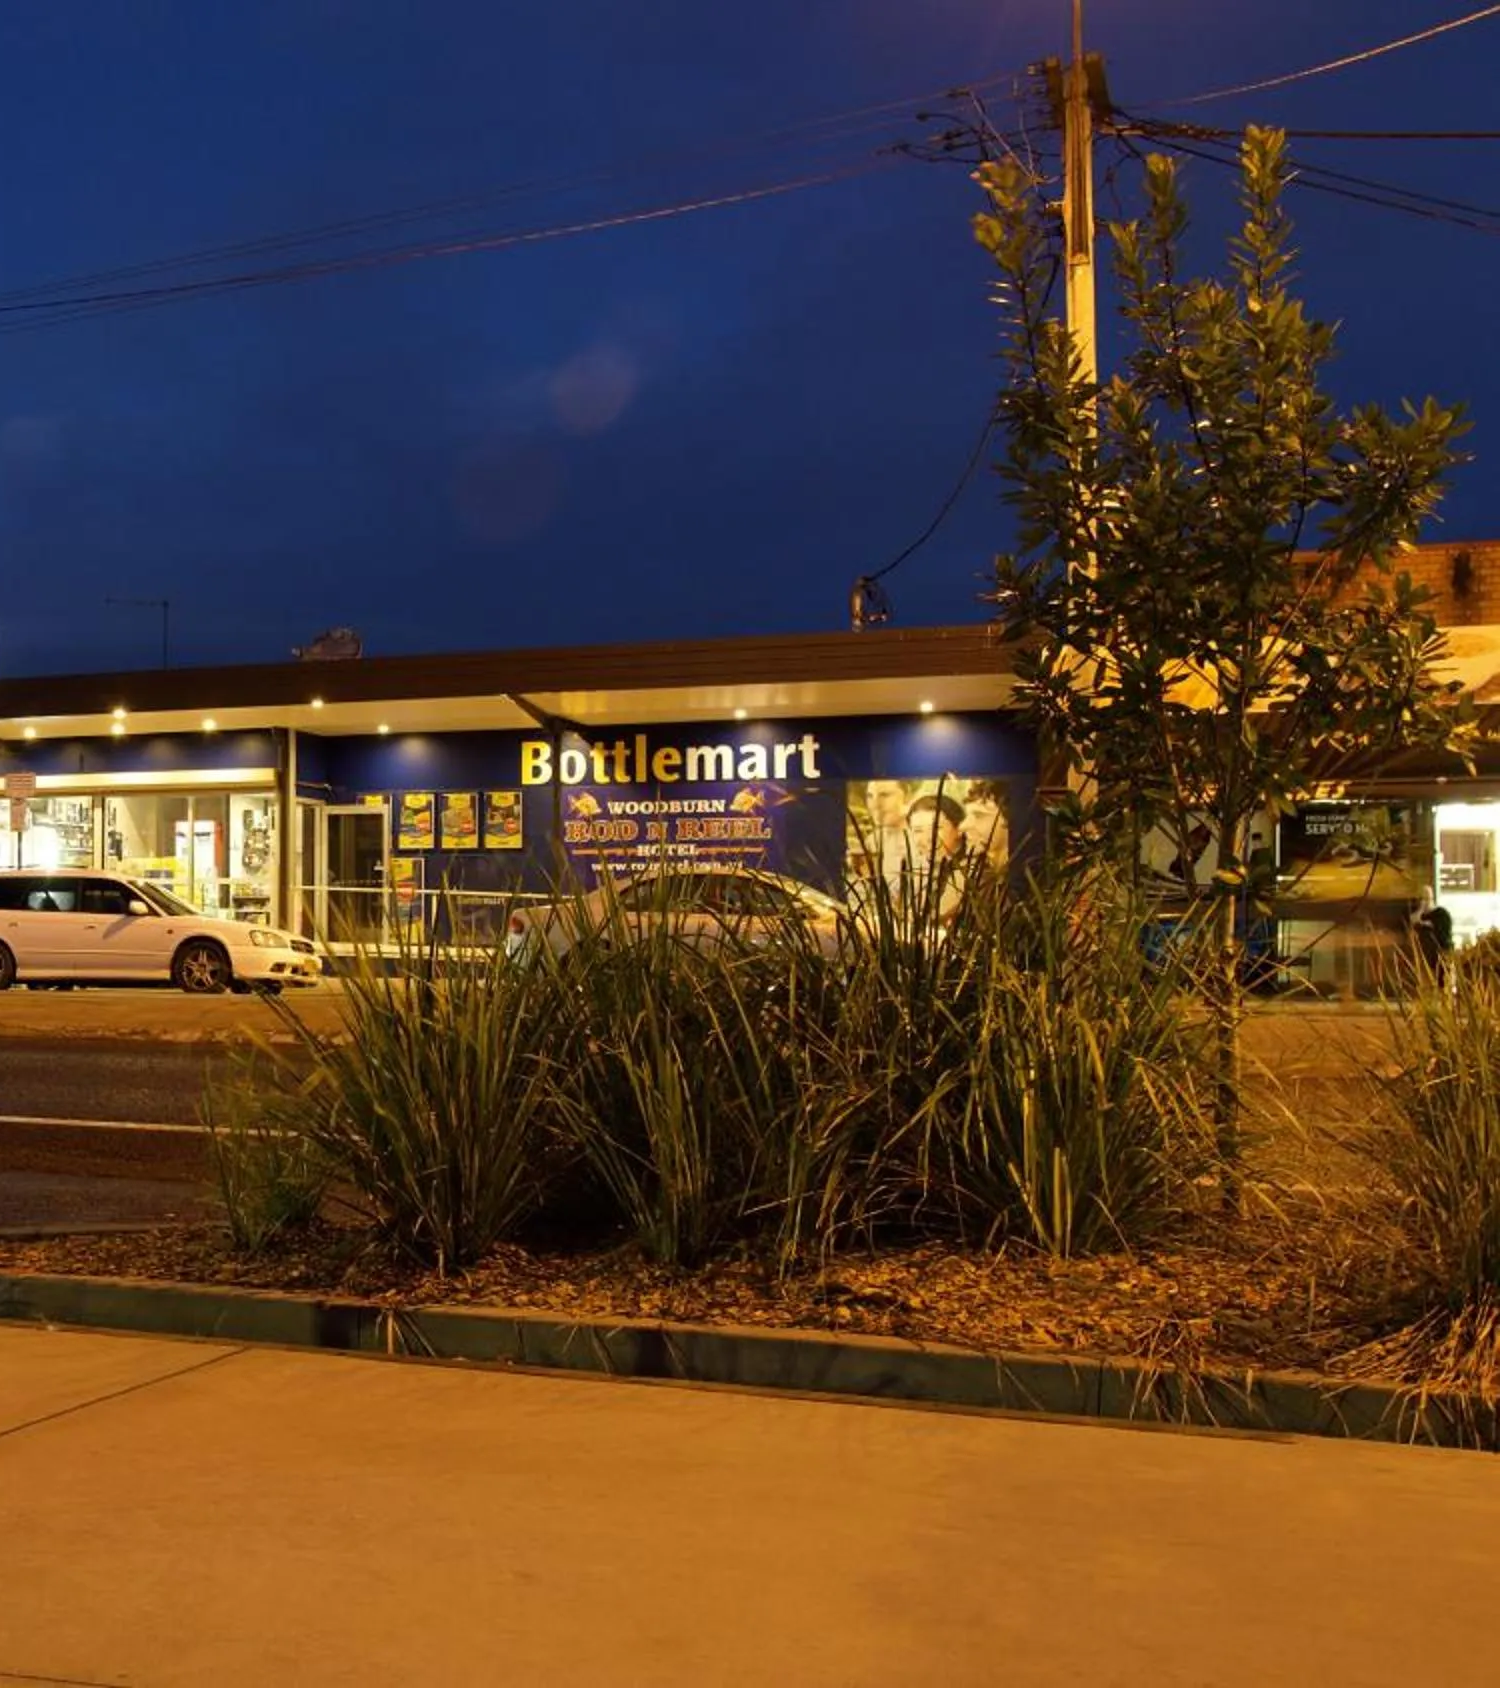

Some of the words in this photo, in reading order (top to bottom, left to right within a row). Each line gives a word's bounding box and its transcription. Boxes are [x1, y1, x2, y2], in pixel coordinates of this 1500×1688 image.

[521, 734, 821, 785] Bottlemart
[607, 799, 726, 815] WOODBURN
[564, 819, 639, 843] ROD
[646, 820, 669, 842] N
[675, 817, 773, 841] REEL
[636, 843, 701, 857] HOTEL
